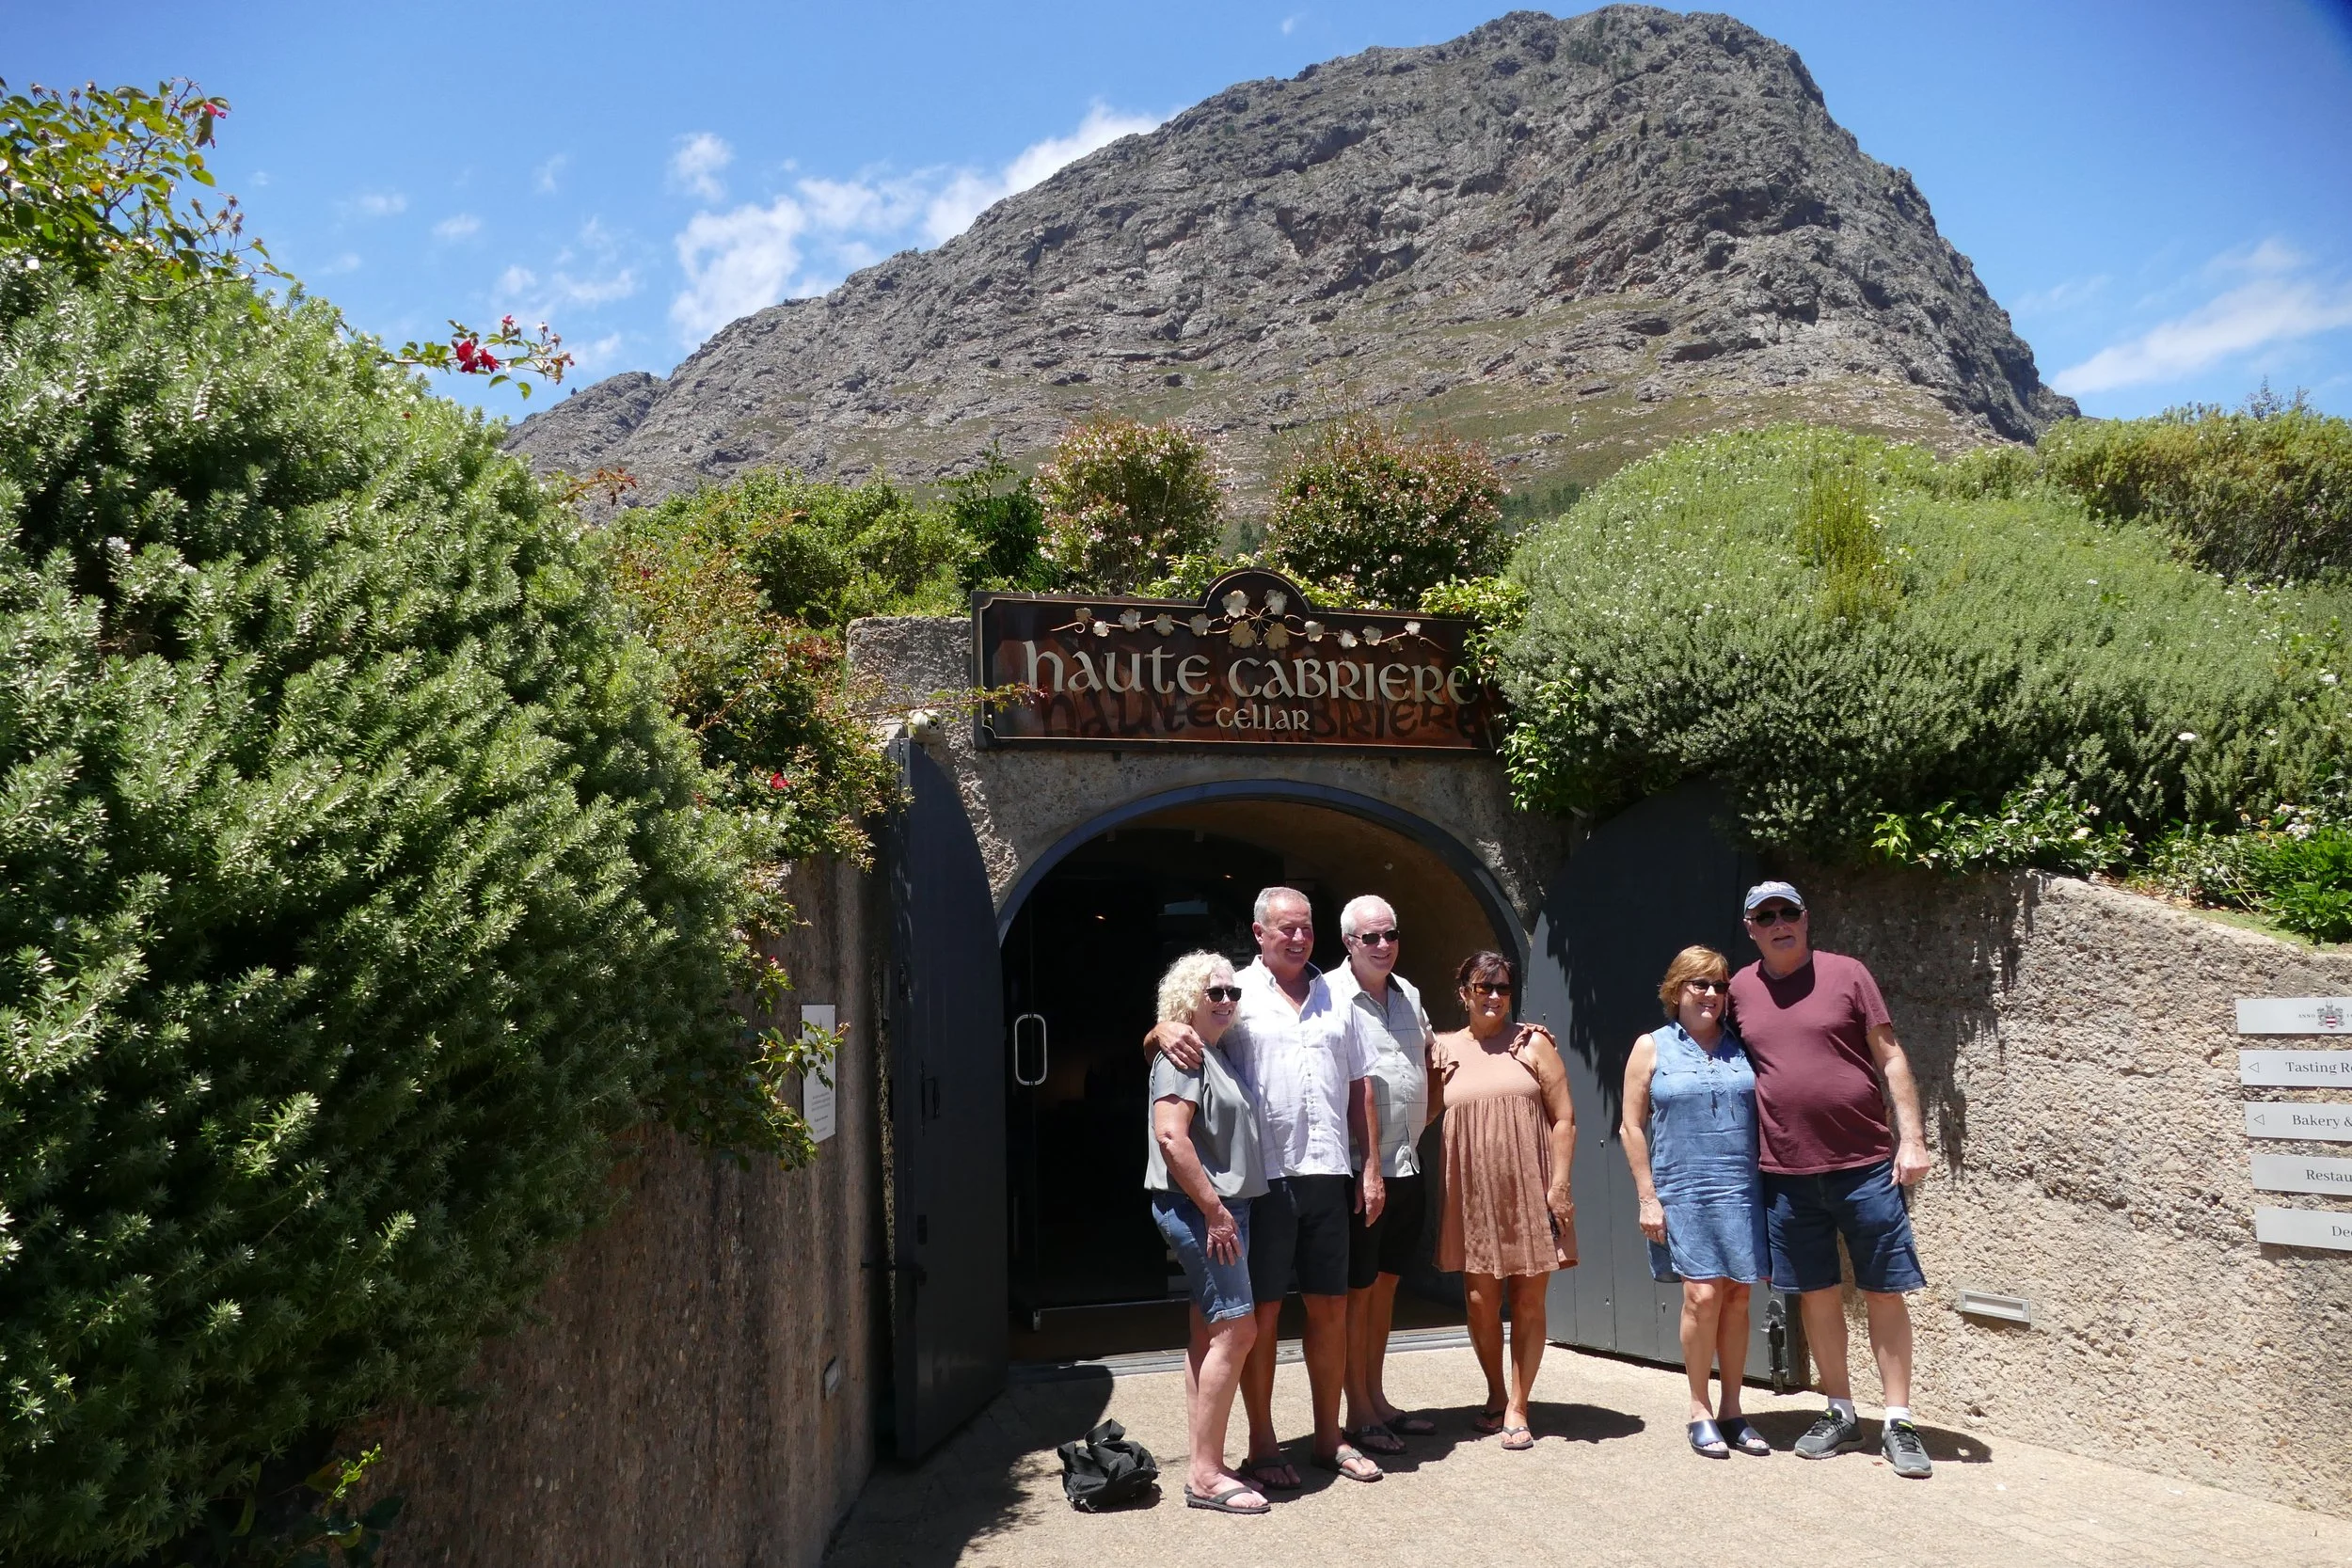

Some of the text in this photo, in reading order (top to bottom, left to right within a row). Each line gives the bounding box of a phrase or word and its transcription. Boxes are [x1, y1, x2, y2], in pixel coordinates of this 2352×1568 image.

[2285, 1061, 2352, 1075] Tasting R
[2293, 1115, 2340, 1129] Bakery
[2332, 1226, 2352, 1237] De
